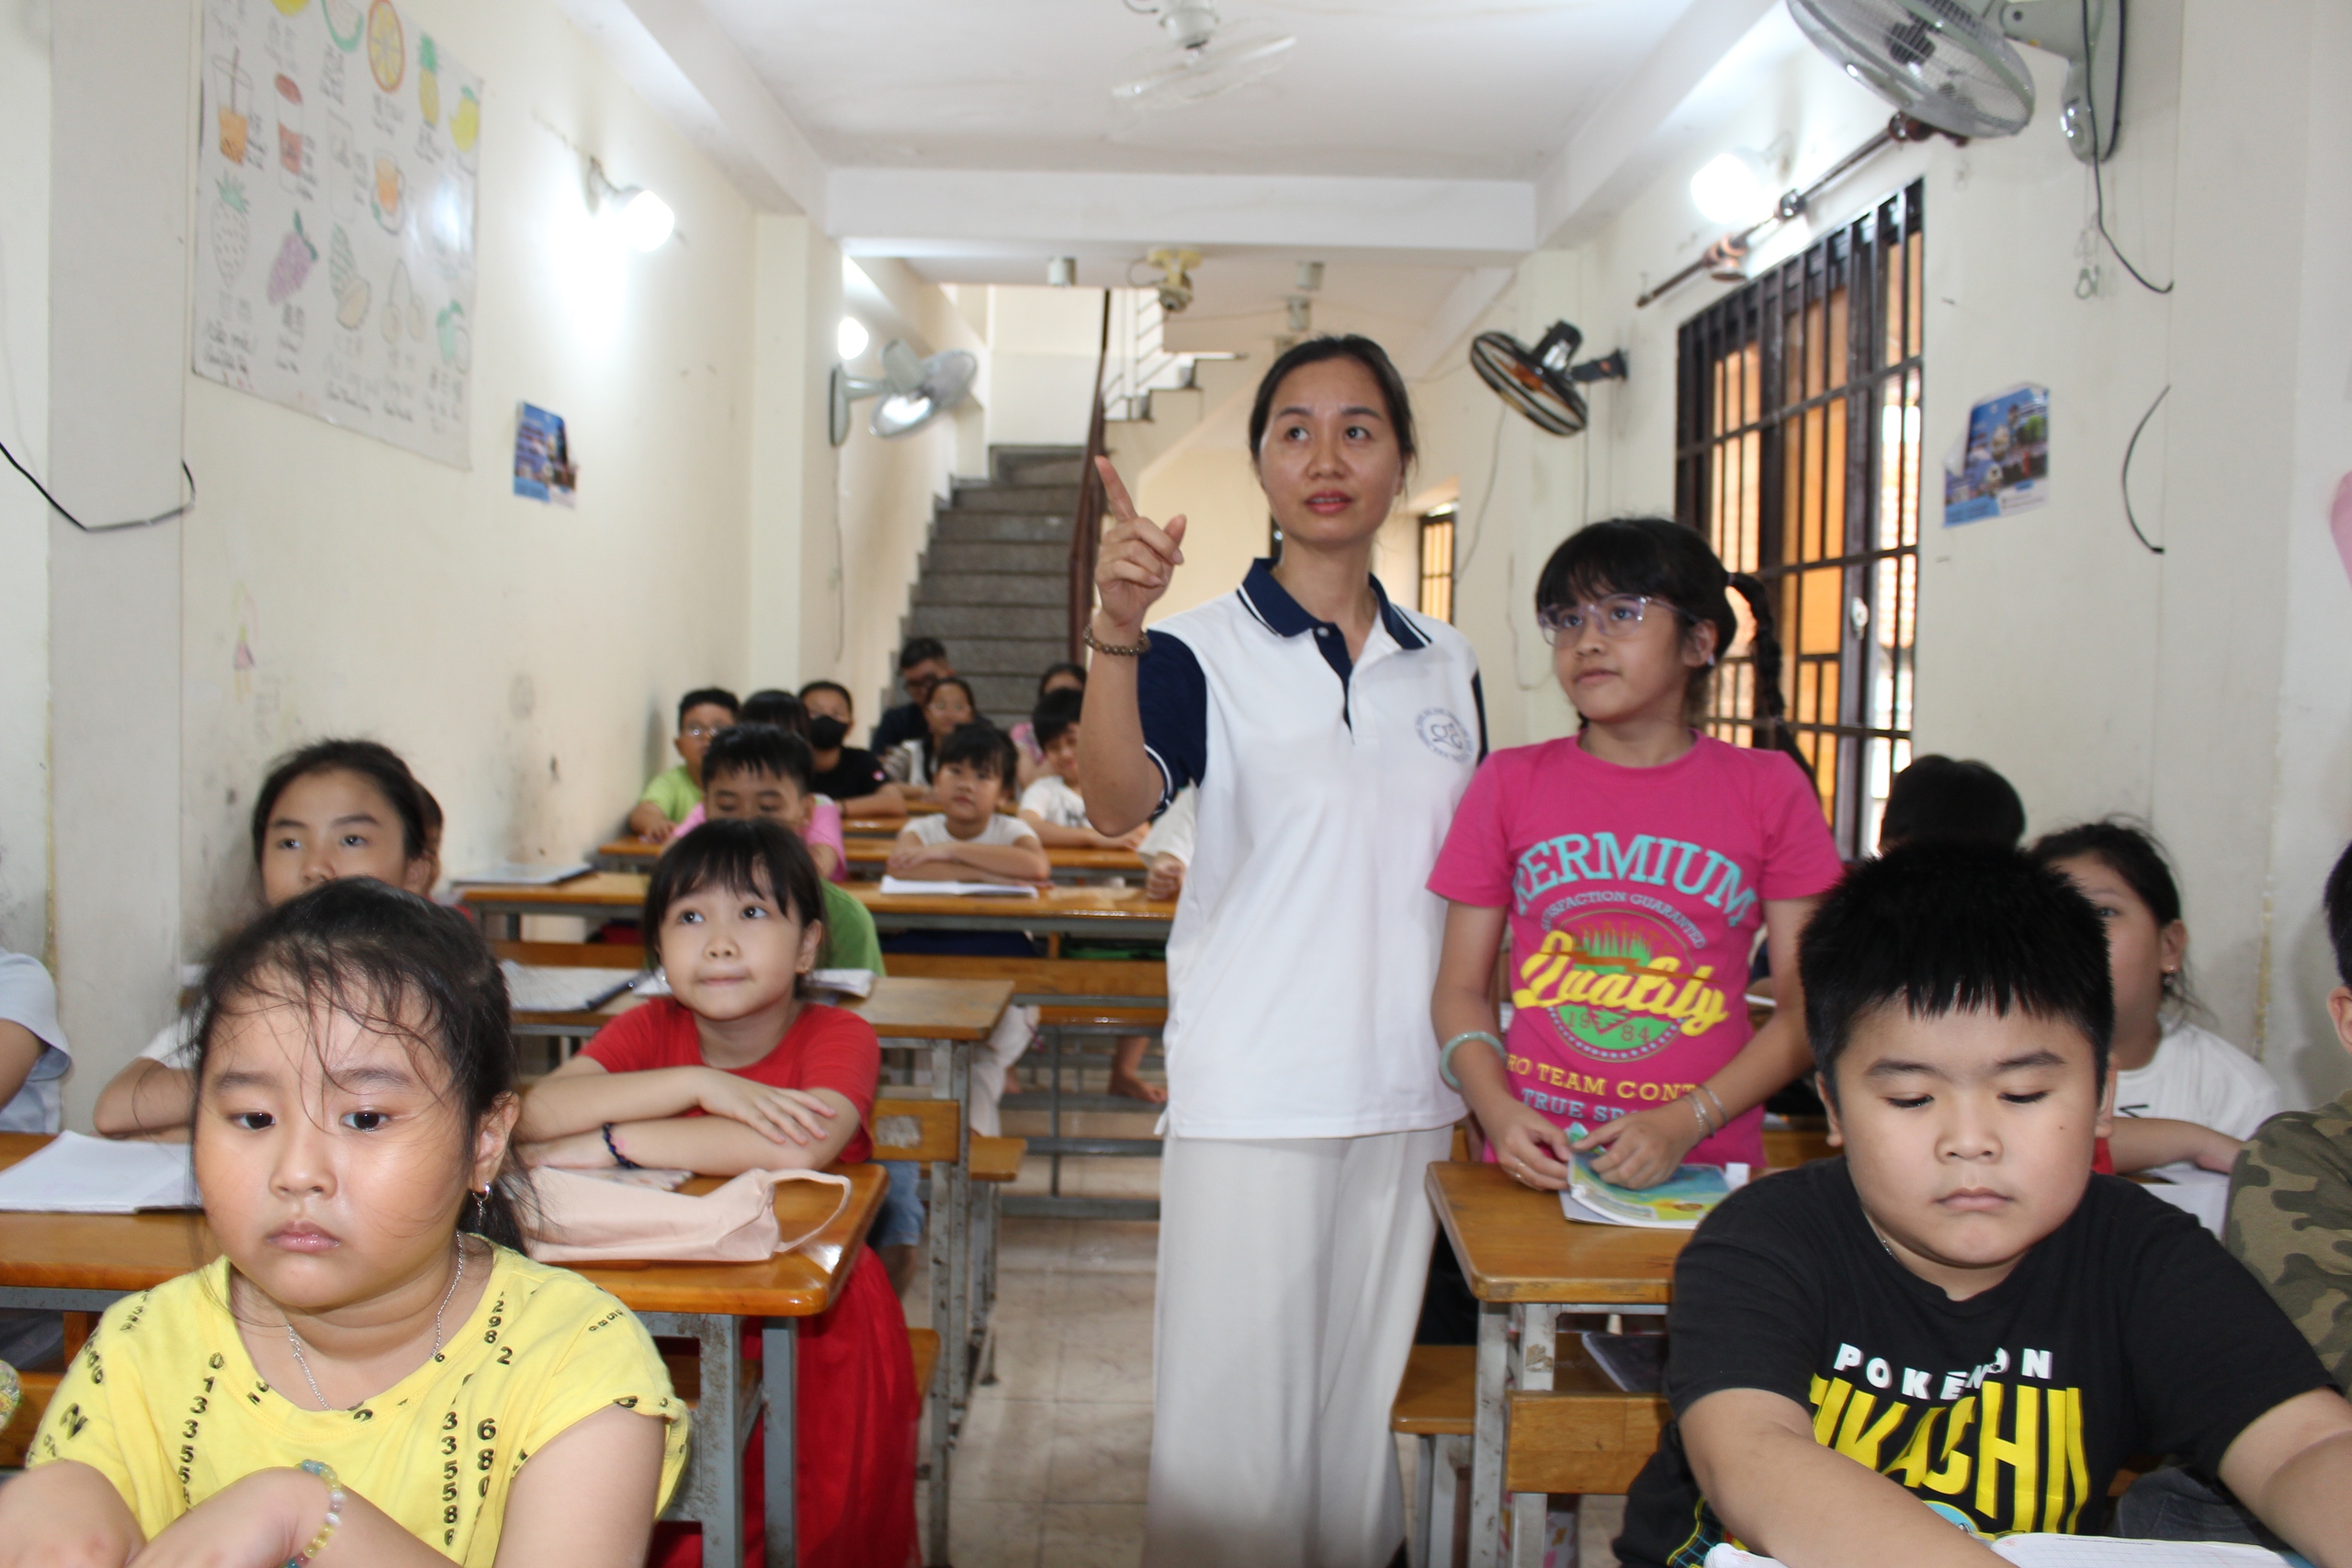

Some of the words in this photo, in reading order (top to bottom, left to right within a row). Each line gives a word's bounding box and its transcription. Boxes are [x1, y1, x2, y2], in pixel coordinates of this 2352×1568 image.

[1512, 931, 1729, 1036] Quality
[1537, 1063, 1606, 1097] TEAM
[1521, 1088, 1585, 1119] TRUE
